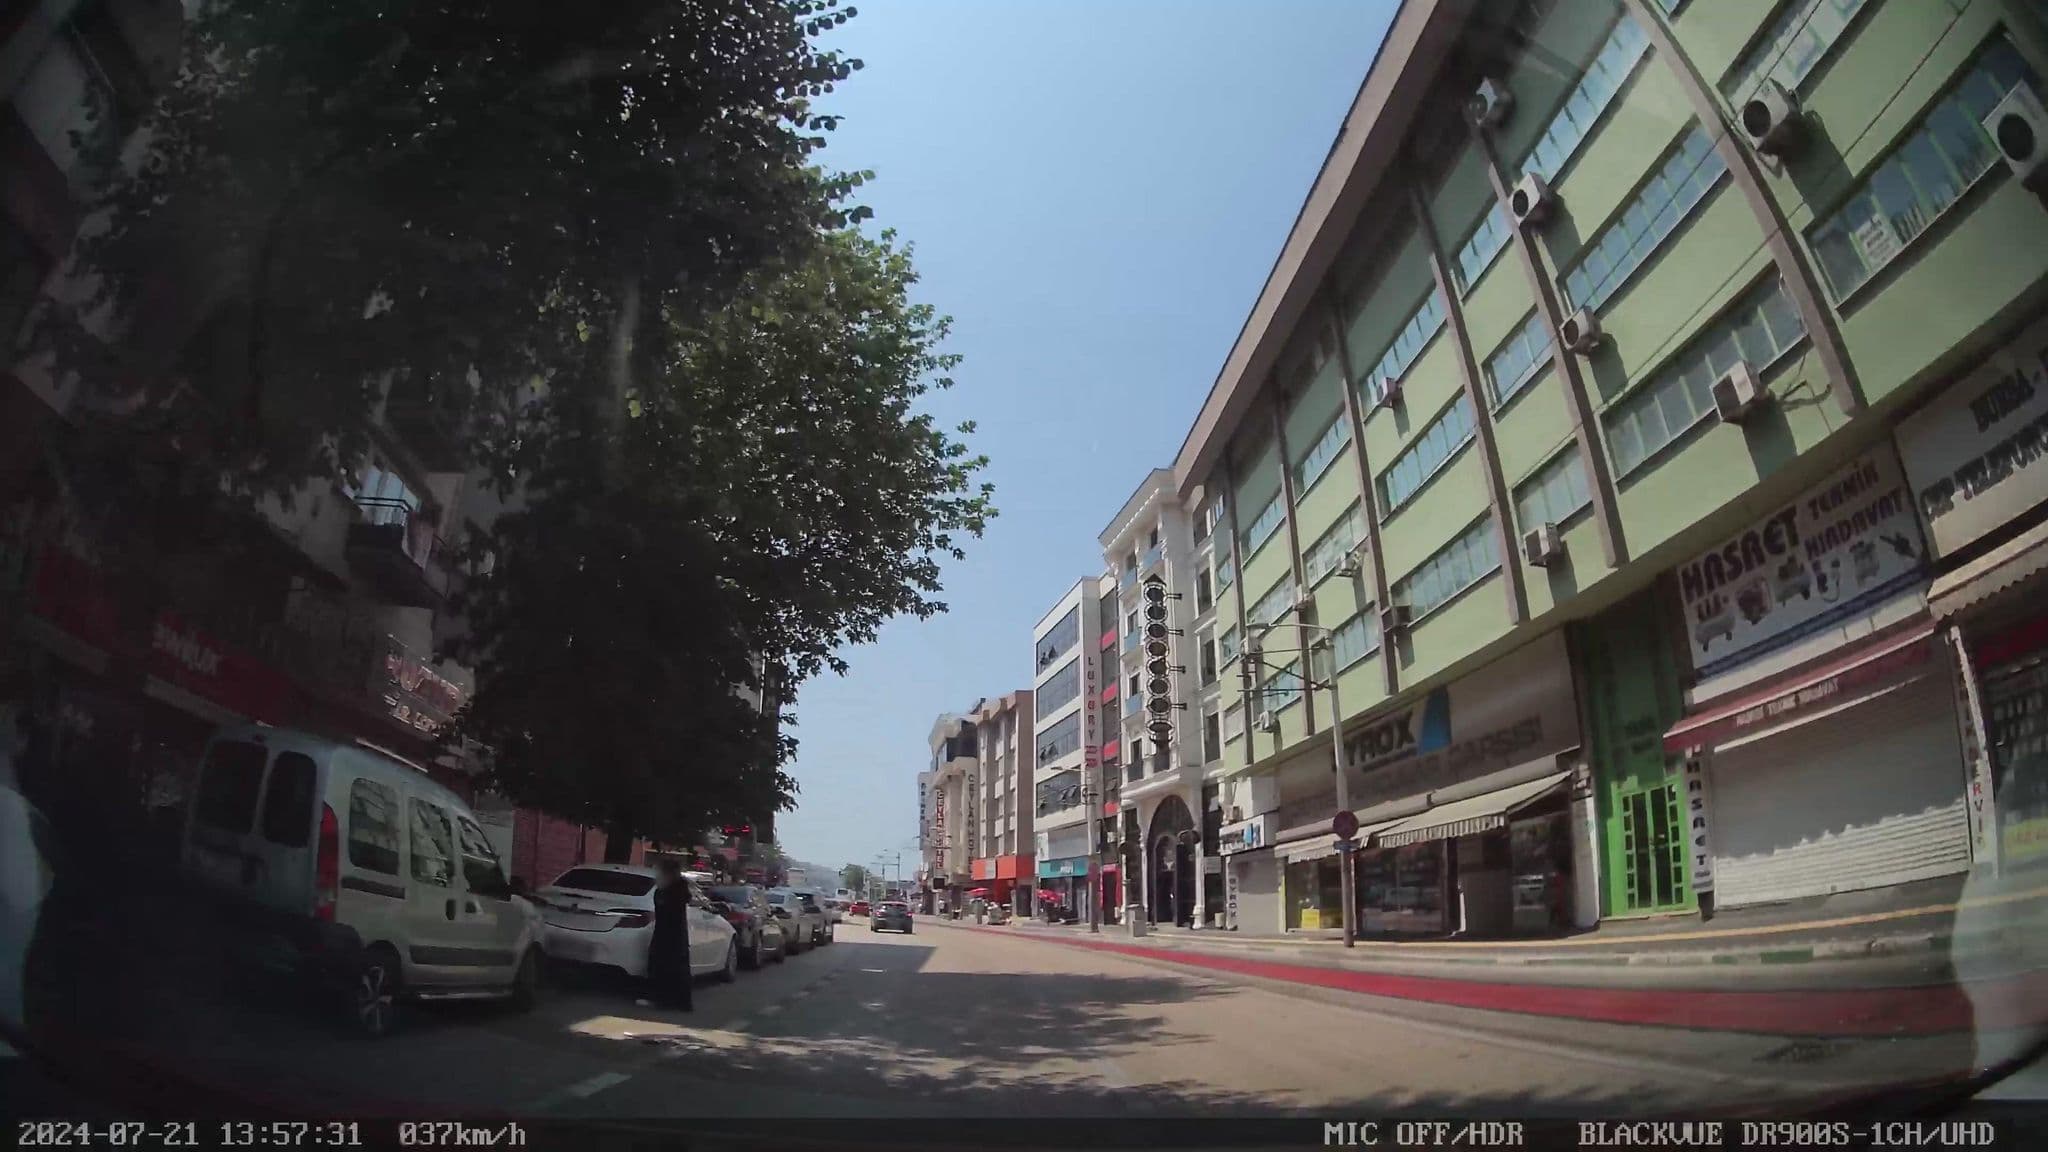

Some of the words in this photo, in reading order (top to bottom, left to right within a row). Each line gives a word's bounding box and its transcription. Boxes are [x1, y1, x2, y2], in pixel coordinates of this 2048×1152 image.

[1680, 504, 1800, 606] HASRET
[1087, 656, 1097, 741] LUXURY
[1330, 709, 1416, 774] YROX
